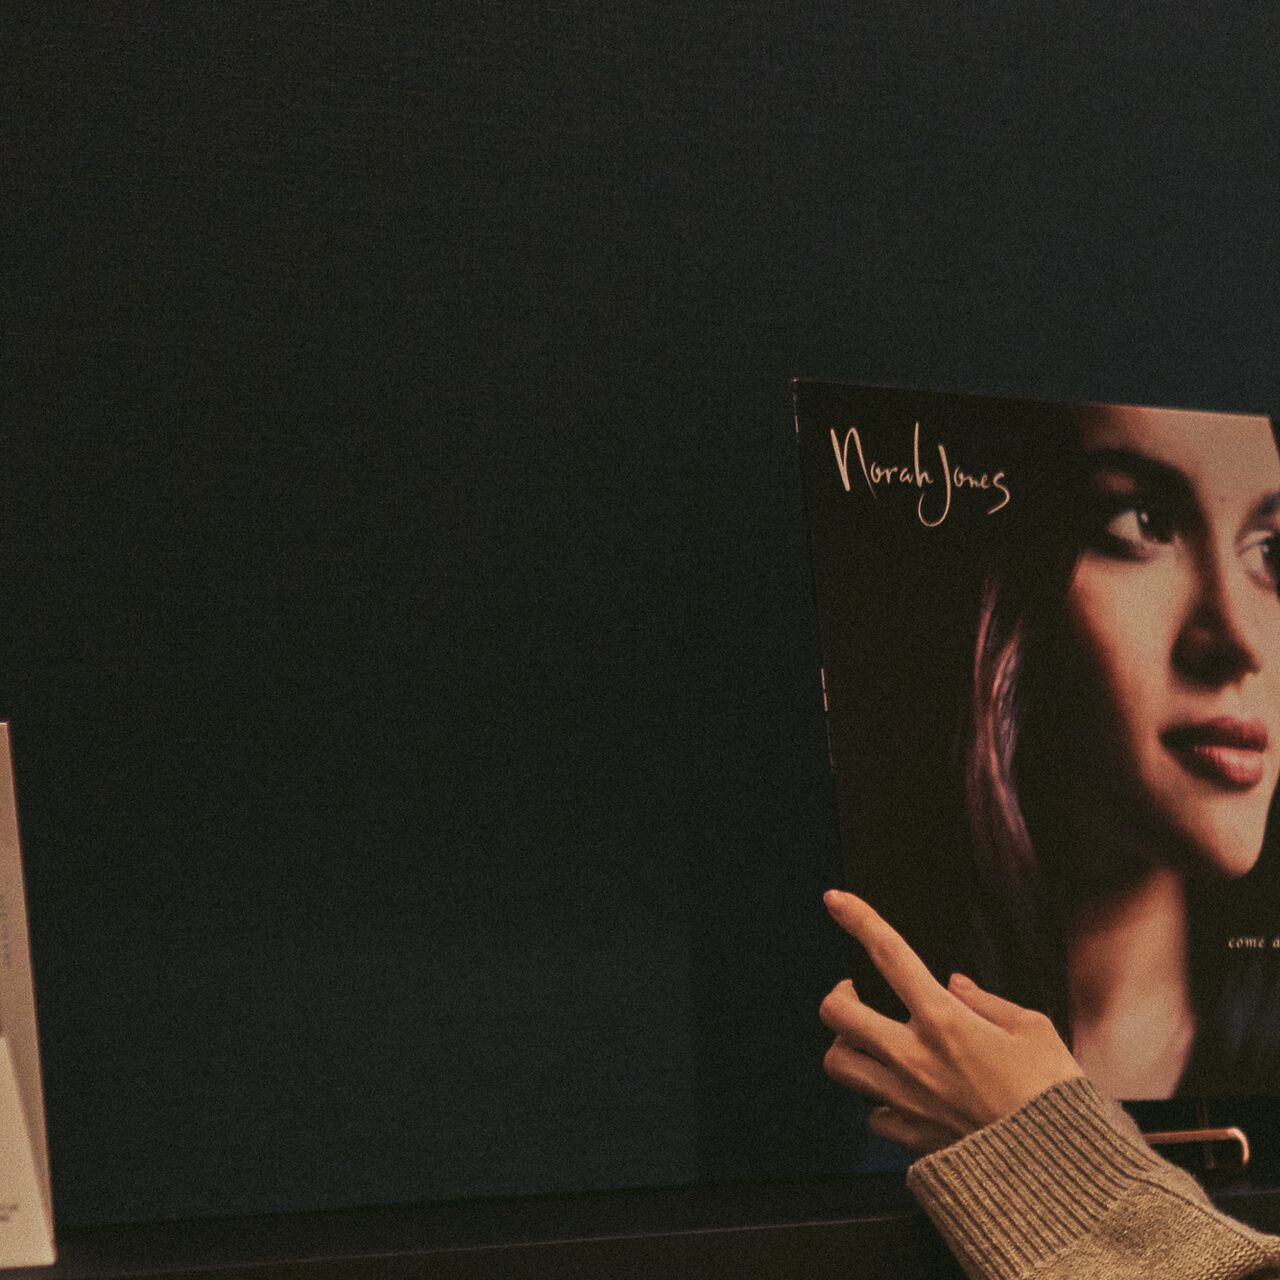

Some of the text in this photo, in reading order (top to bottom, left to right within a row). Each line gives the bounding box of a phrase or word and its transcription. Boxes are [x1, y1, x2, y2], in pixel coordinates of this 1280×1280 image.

[830, 421, 1010, 528] Norah Jones
[1228, 936, 1265, 950] come
